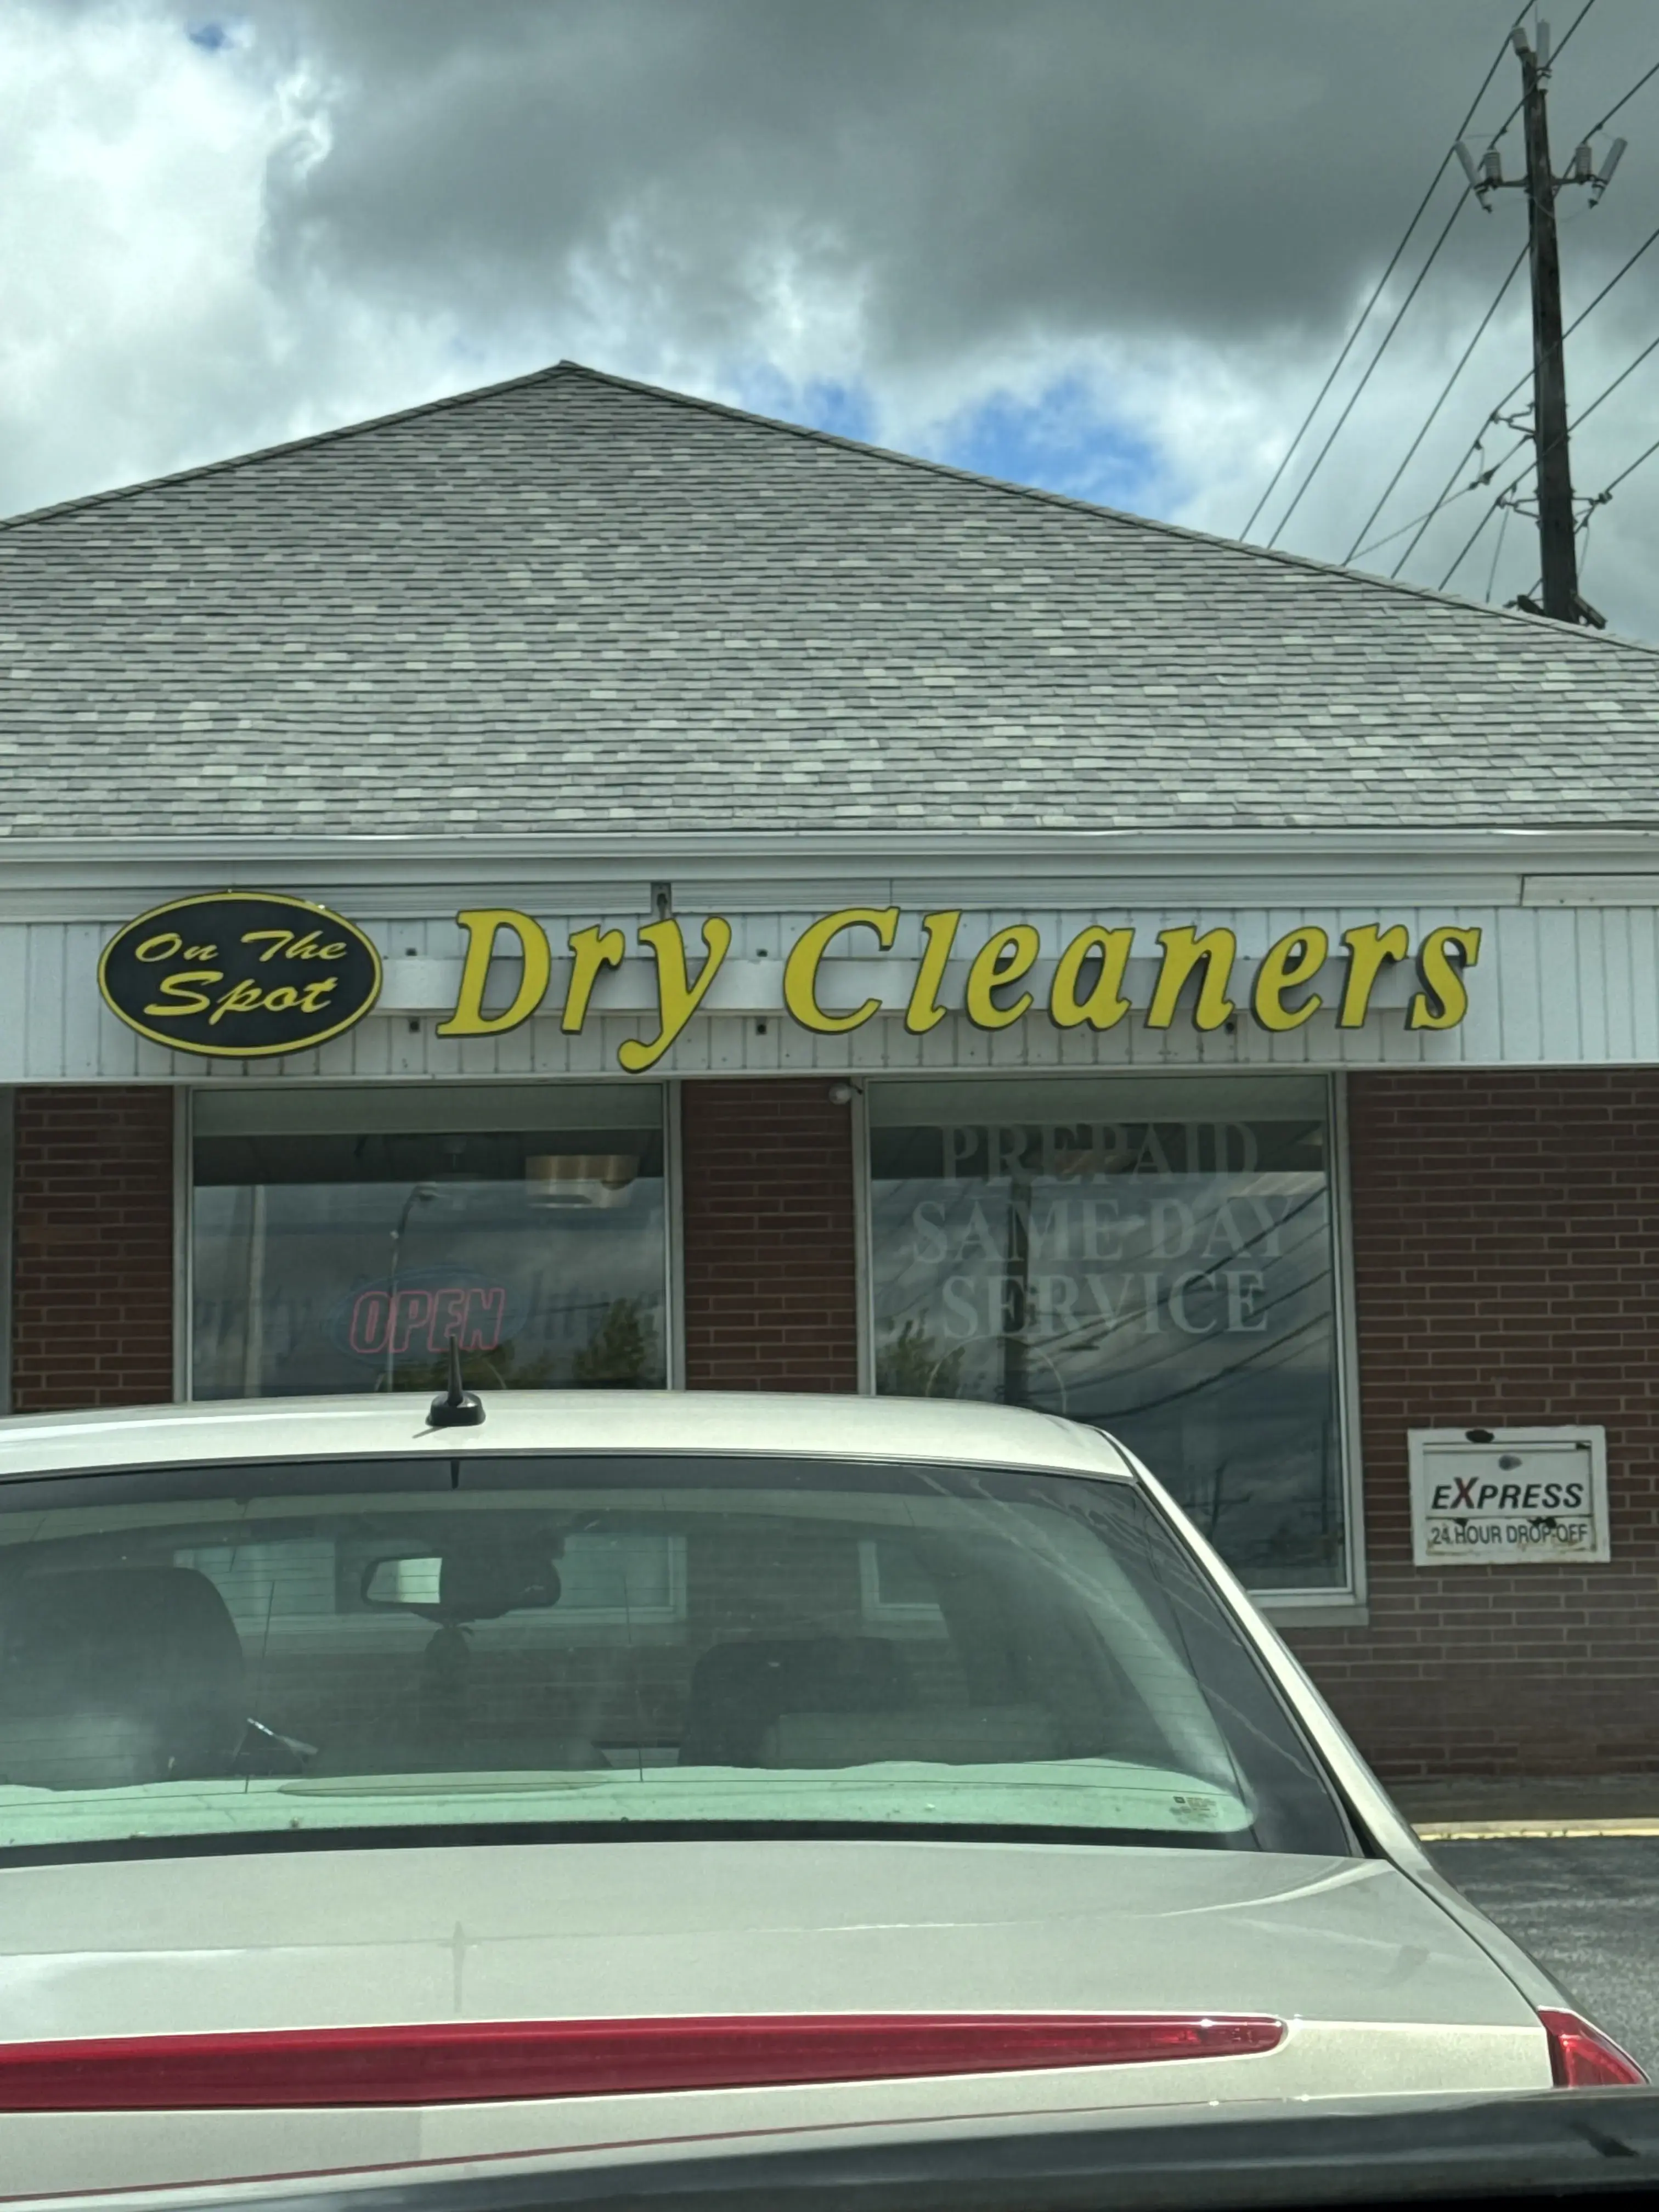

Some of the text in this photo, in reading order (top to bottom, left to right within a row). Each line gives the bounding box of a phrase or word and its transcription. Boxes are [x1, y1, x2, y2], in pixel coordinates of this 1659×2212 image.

[135, 930, 347, 962] On The
[144, 970, 338, 1025] Spot
[435, 906, 1482, 1074] Dry Cleaners
[939, 1122, 1259, 1186] PREPAID
[1145, 1195, 1295, 1259] DAY
[349, 1288, 506, 1353] OPEN
[941, 1269, 1269, 1339] SERVICE
[1454, 1525, 1503, 1544] HOUR
